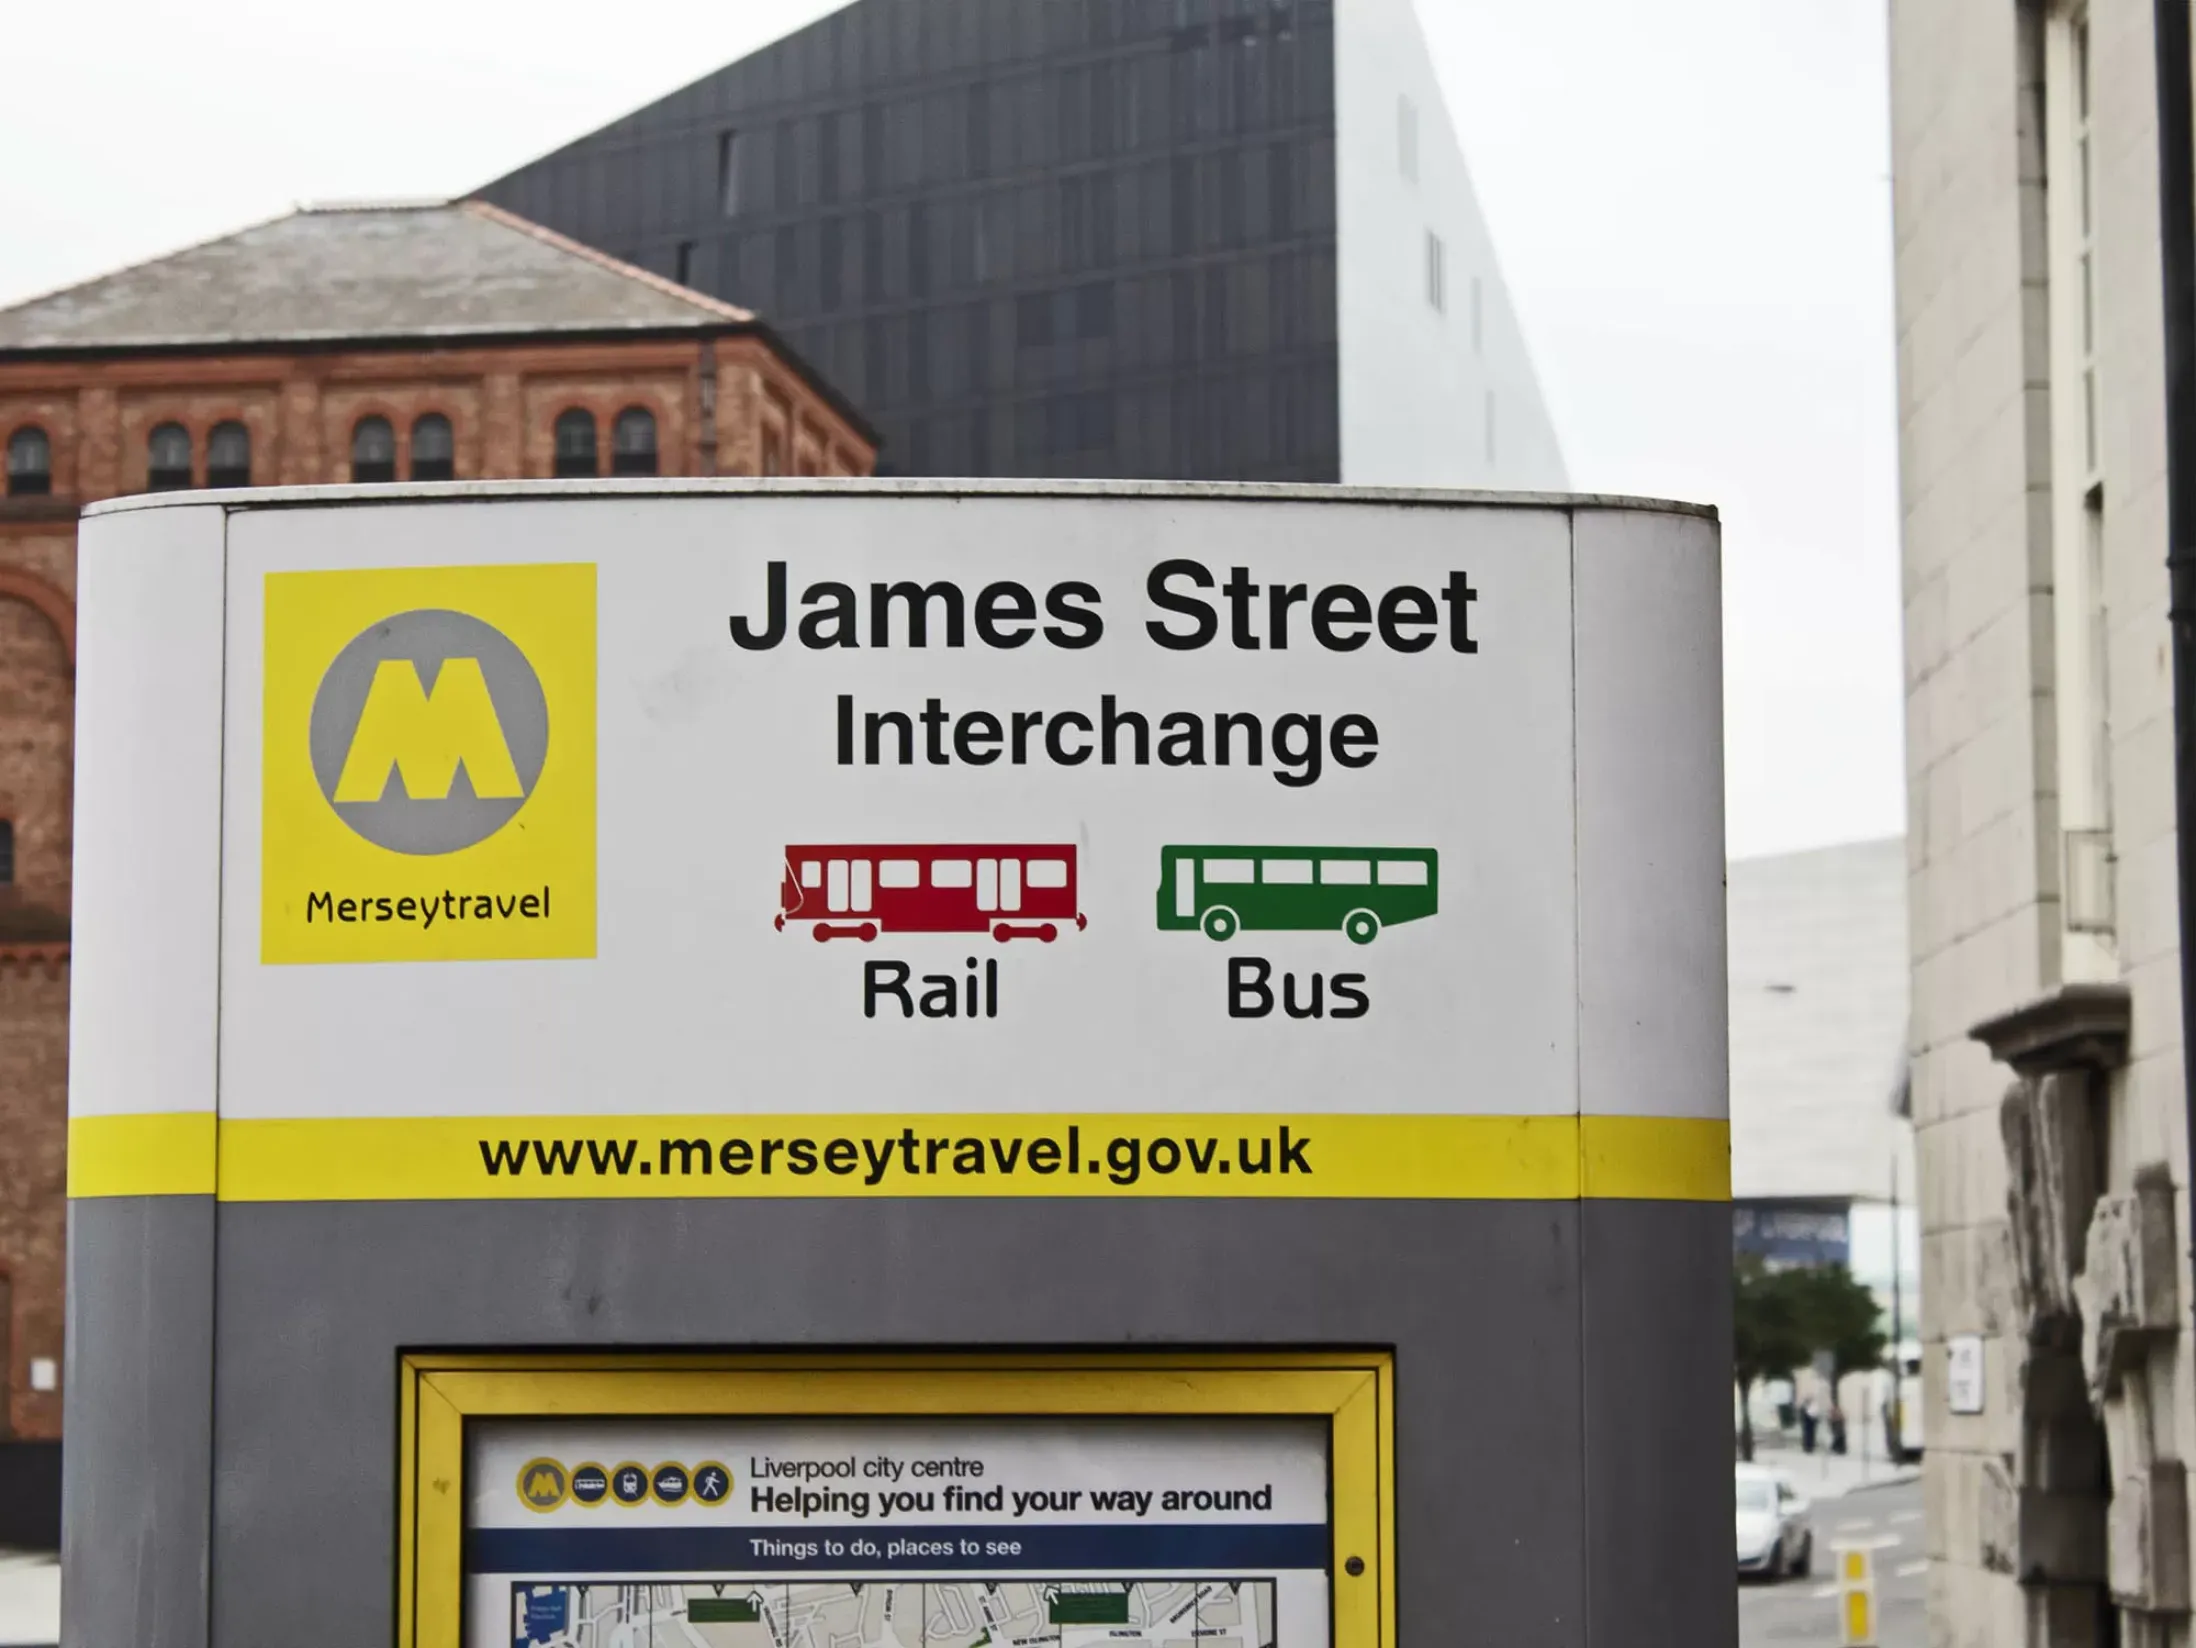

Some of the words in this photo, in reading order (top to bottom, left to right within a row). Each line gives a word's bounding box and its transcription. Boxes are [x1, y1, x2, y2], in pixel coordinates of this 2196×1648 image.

[729, 561, 1104, 651] James
[1145, 558, 1478, 654] Street
[837, 694, 1379, 788] Interchange
[306, 885, 550, 930] Merseytravel
[863, 956, 998, 1019] Rail
[1228, 956, 1370, 1019] Bus
[478, 1125, 1313, 1186] www.merseytravel.gov.uk
[750, 1456, 856, 1483] Liverpool
[862, 1455, 905, 1483] city
[910, 1456, 985, 1478] centre
[751, 1485, 870, 1519] Helping
[877, 1491, 935, 1518] you
[942, 1484, 1004, 1512] find
[1011, 1490, 1083, 1518] your
[1089, 1490, 1154, 1517] way
[1161, 1483, 1272, 1511] around
[749, 1538, 819, 1561] Things
[824, 1539, 845, 1557] to
[849, 1538, 882, 1560] do,
[887, 1537, 954, 1560] places
[959, 1538, 980, 1556] to
[985, 1541, 1022, 1556] see
